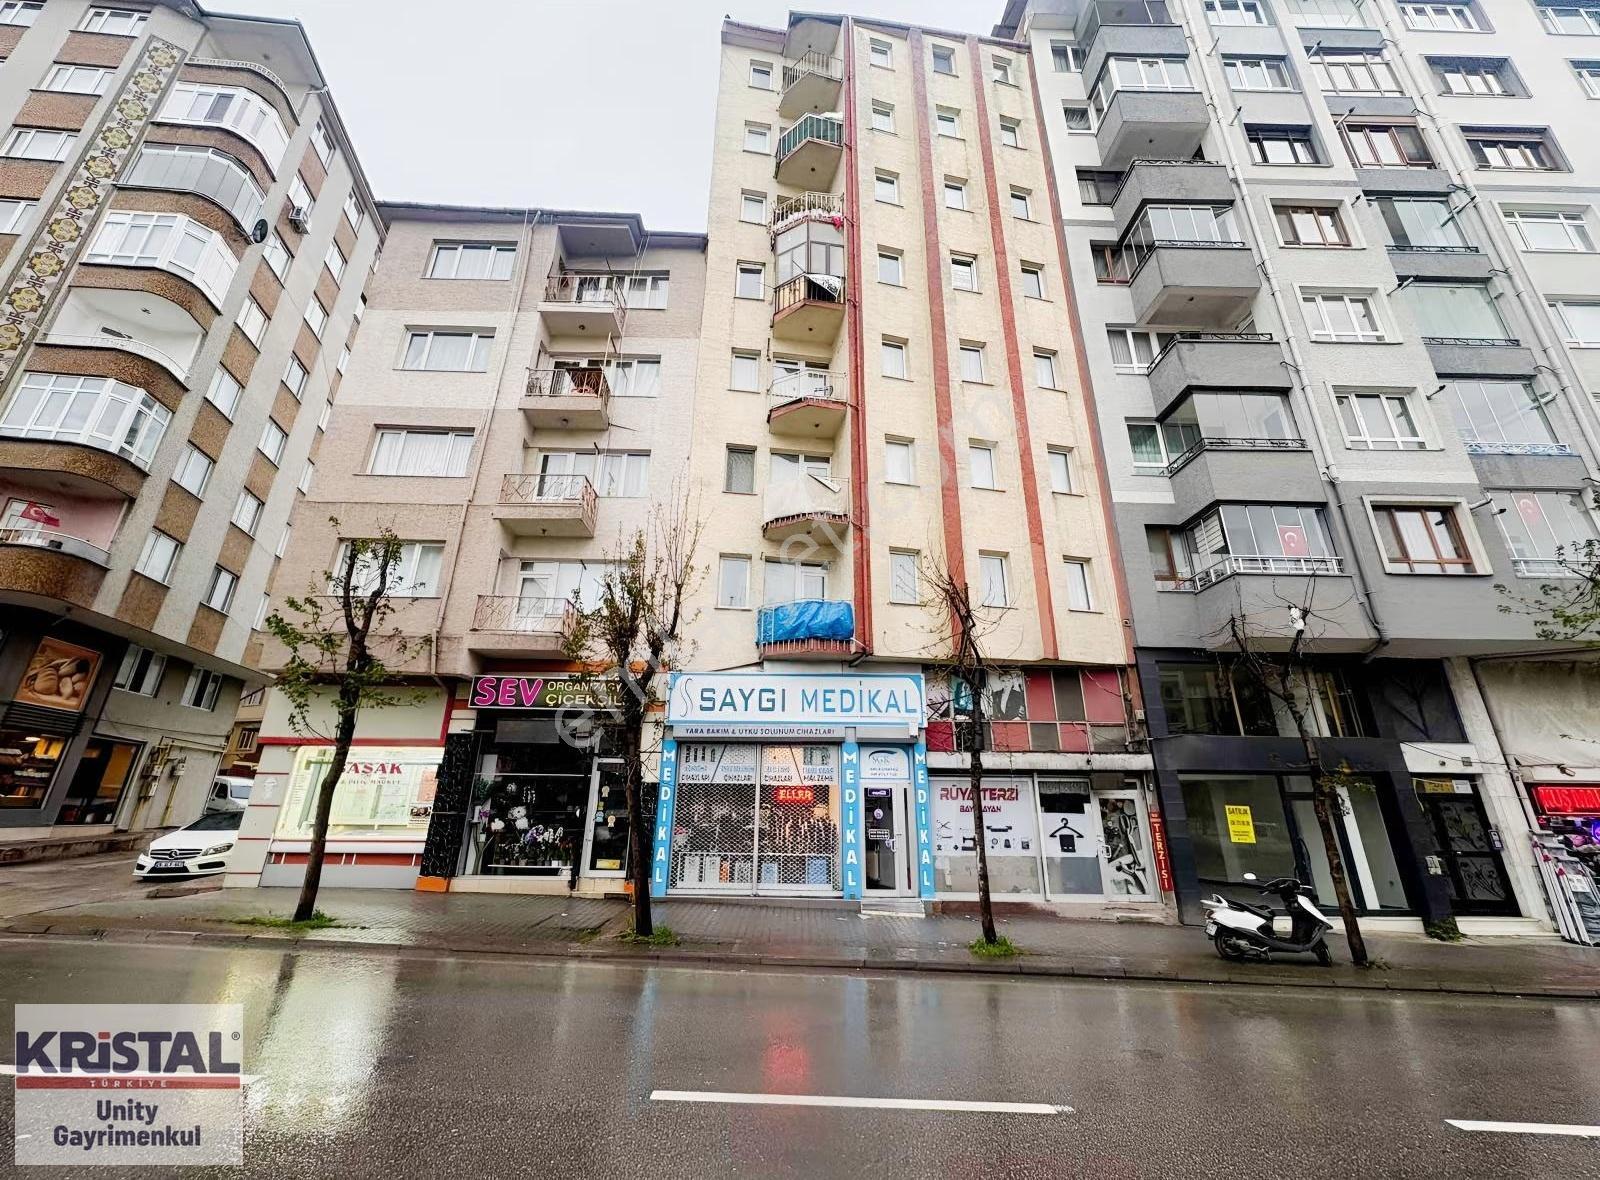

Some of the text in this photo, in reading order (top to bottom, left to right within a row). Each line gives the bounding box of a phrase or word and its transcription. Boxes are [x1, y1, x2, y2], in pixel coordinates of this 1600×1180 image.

[474, 677, 543, 706] SEV
[699, 680, 917, 713] SAYGI MEDİKAL
[342, 762, 402, 777] AŞAK
[655, 750, 676, 883] MEDİKAL
[843, 751, 858, 886] MEDİKAL
[914, 751, 931, 886] MEDİKAL
[980, 805, 1002, 813] AYAN
